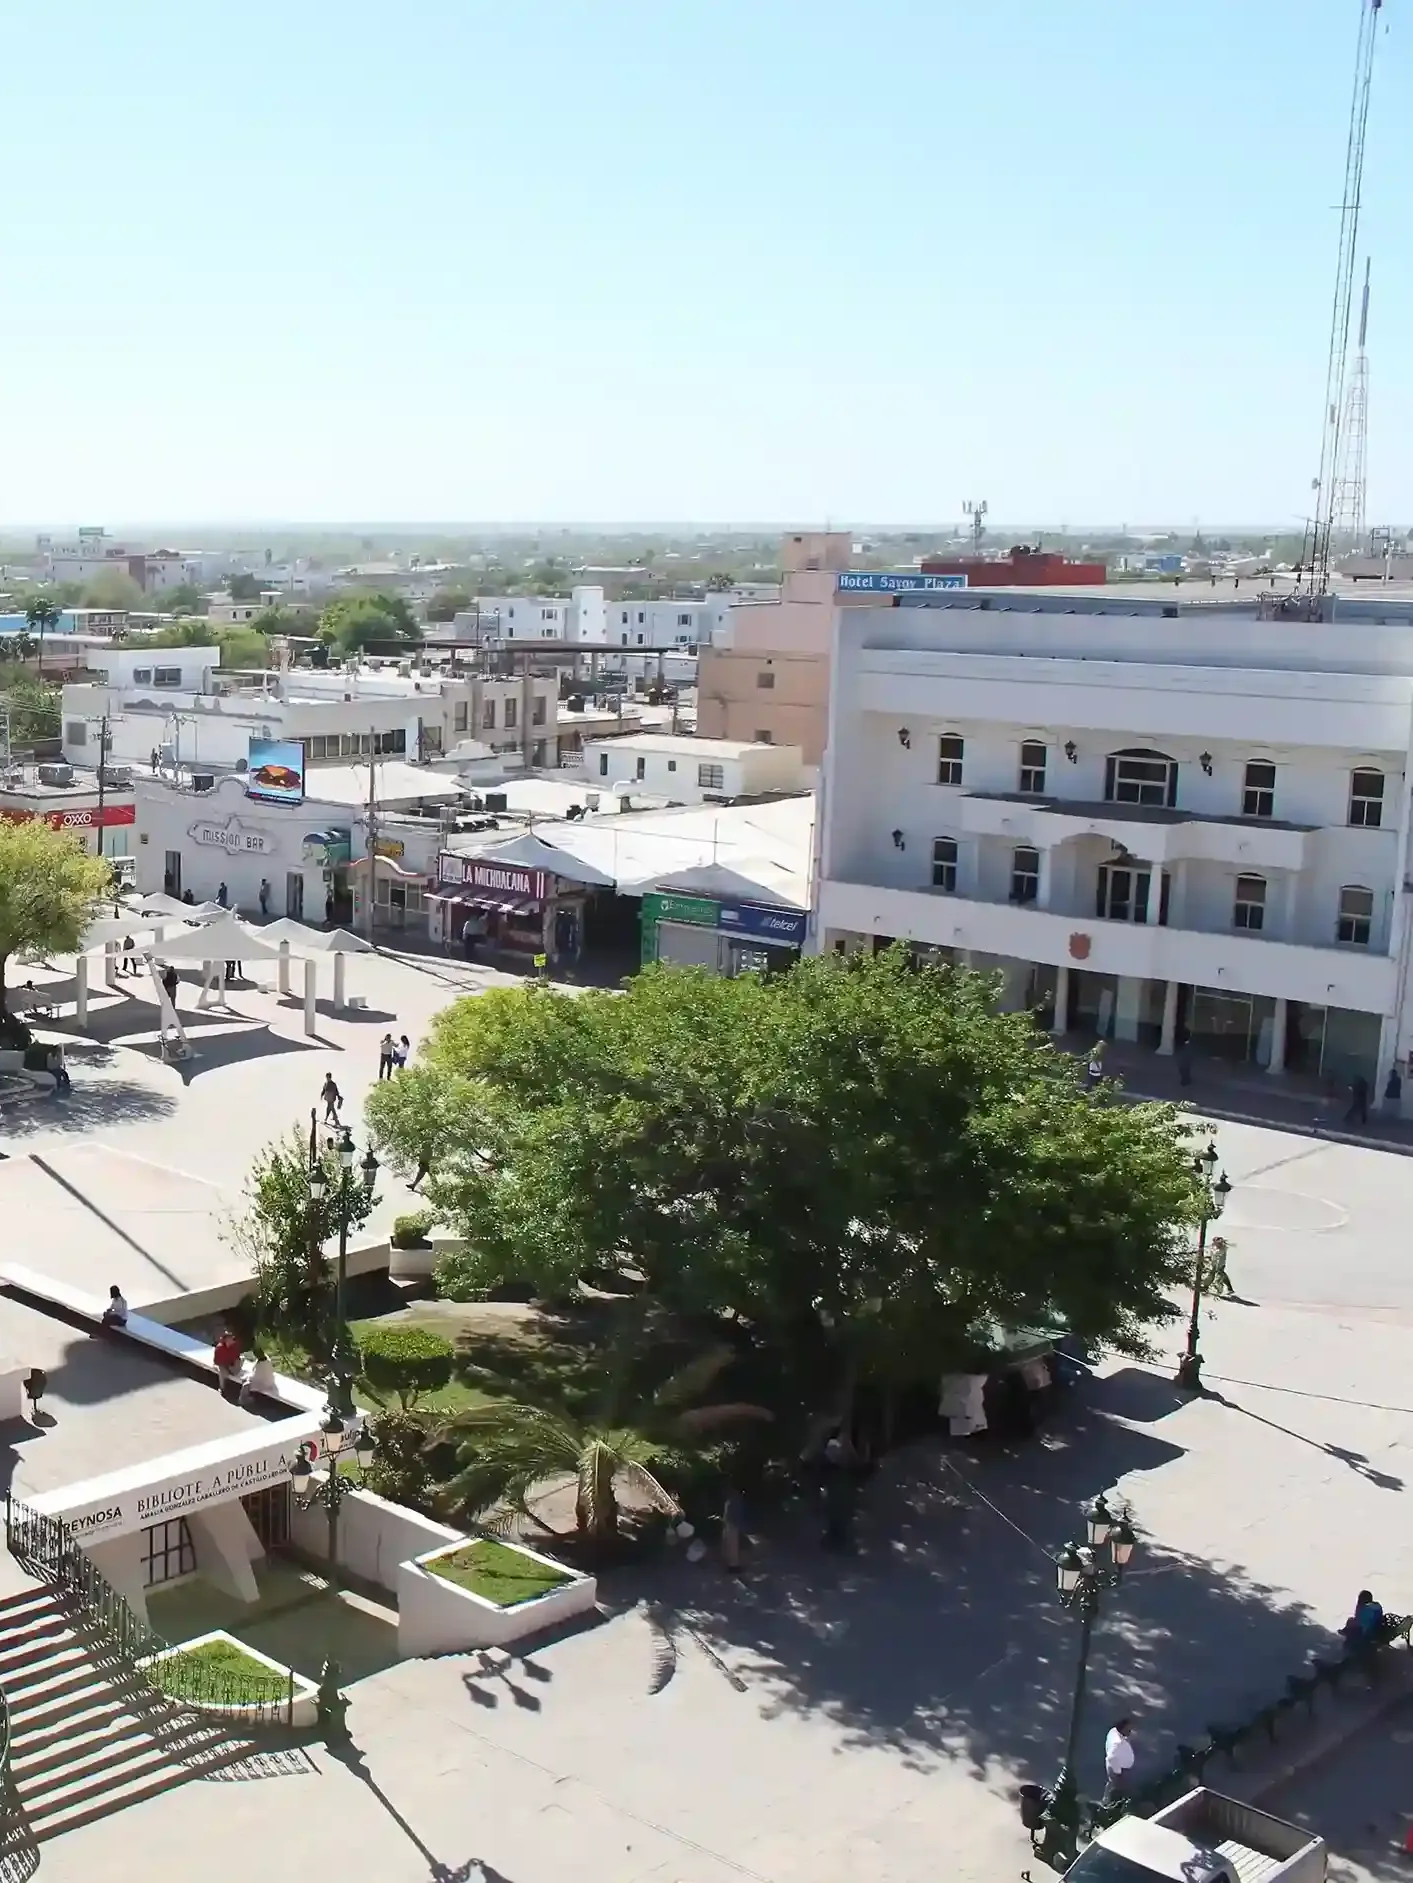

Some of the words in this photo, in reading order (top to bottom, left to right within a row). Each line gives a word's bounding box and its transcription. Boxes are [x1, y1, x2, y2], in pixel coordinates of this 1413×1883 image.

[840, 575, 873, 588] Hotel
[880, 576, 917, 589] Savoy
[924, 577, 960, 589] Plaza
[63, 812, 92, 826] OXXO
[202, 827, 240, 847] MISSION
[246, 836, 265, 850] BAR
[462, 864, 473, 883] LA
[474, 866, 530, 892] MICHOACANA
[769, 916, 798, 931] telcel
[137, 1475, 221, 1513] BIBLIOTEA
[227, 1453, 287, 1484] PÚBLIA
[139, 1508, 164, 1520] AMALIA
[196, 1485, 231, 1502] CABALLERO
[63, 1506, 123, 1534] REYNOSA
